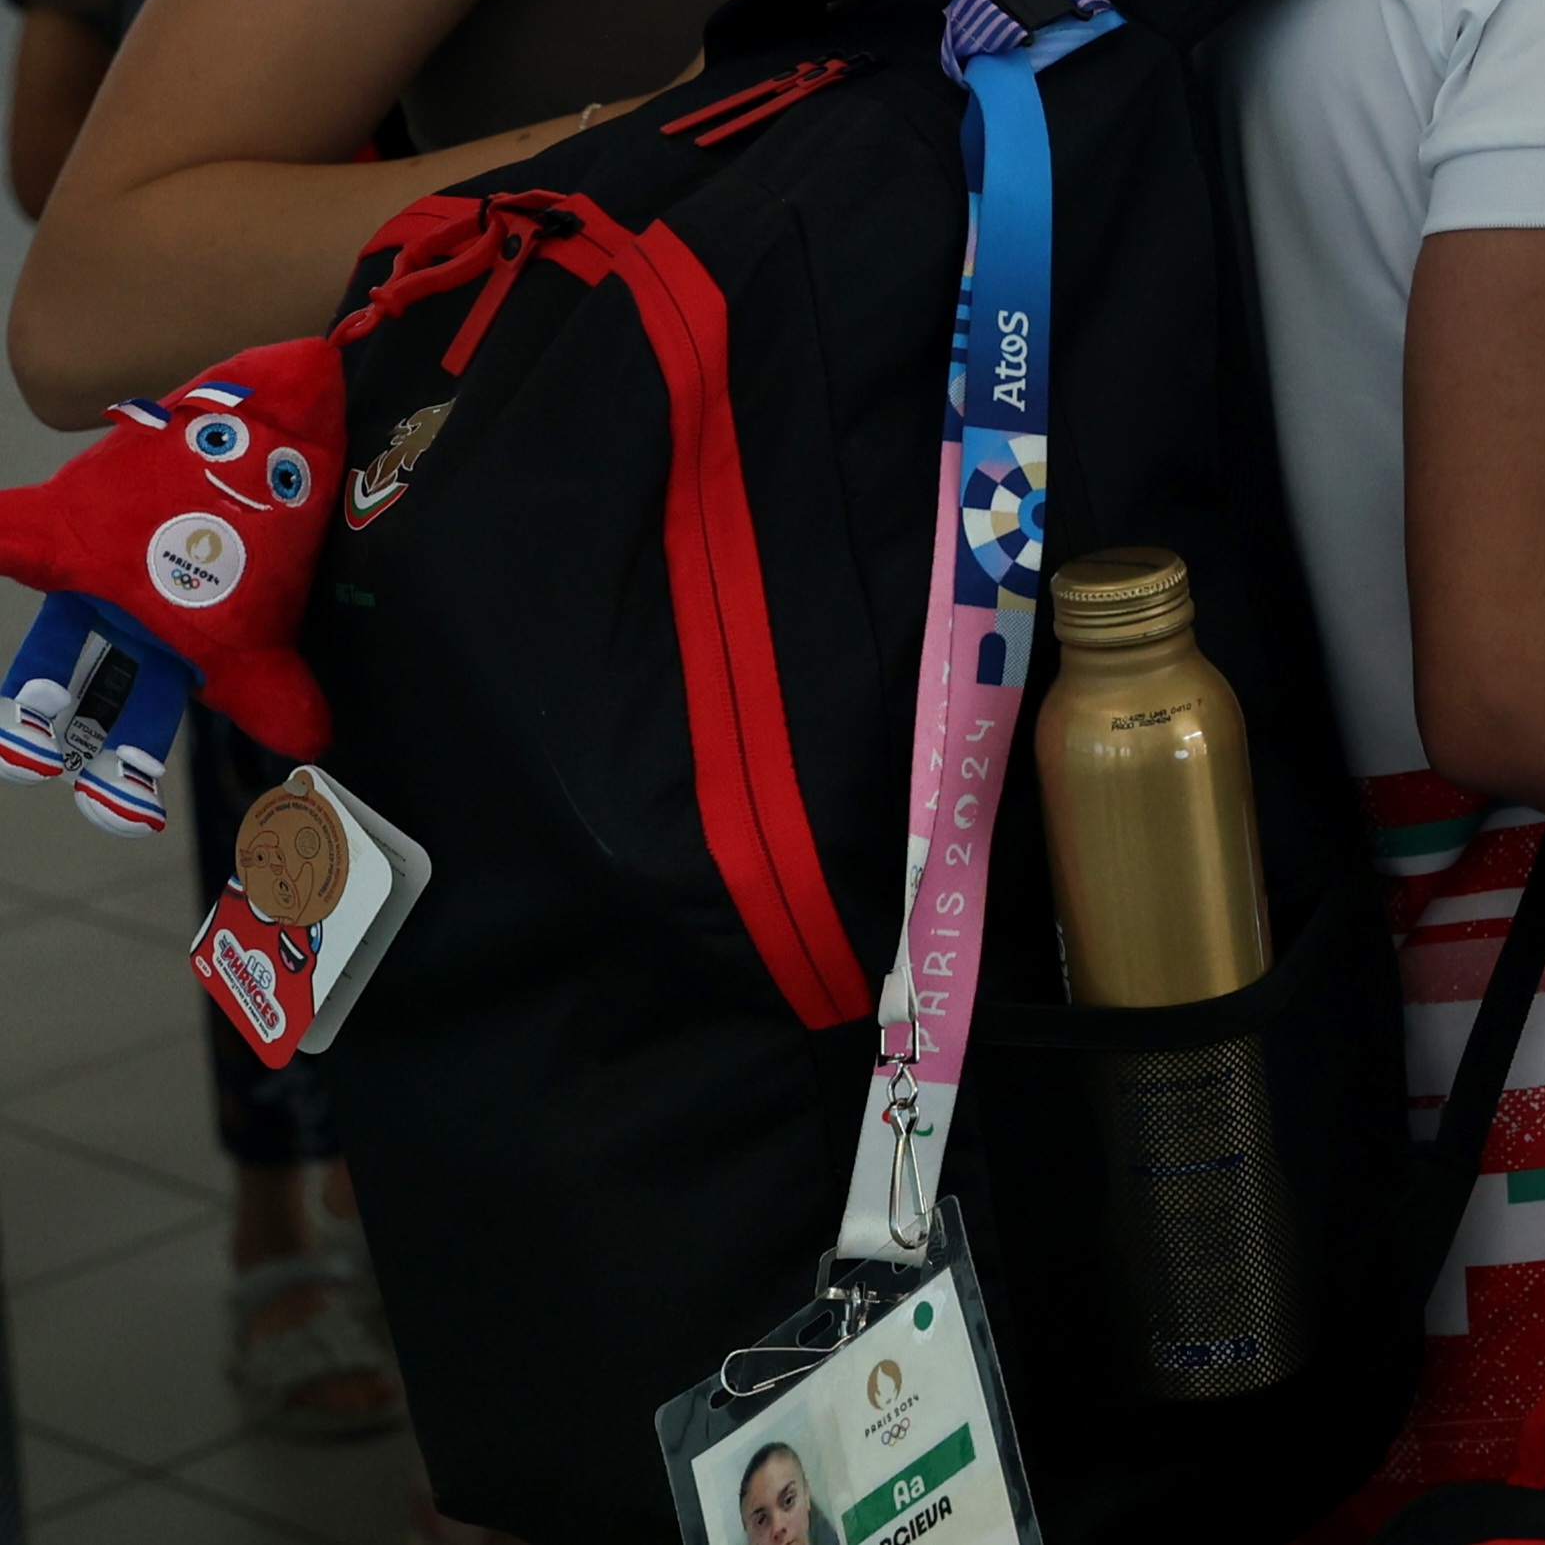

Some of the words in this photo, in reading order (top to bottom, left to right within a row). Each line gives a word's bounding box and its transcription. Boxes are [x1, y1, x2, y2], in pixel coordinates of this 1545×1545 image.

[193, 567, 220, 586] 2024
[245, 955, 273, 990] LES
[893, 1393, 920, 1417] 2024
[892, 1474, 926, 1511] Aa
